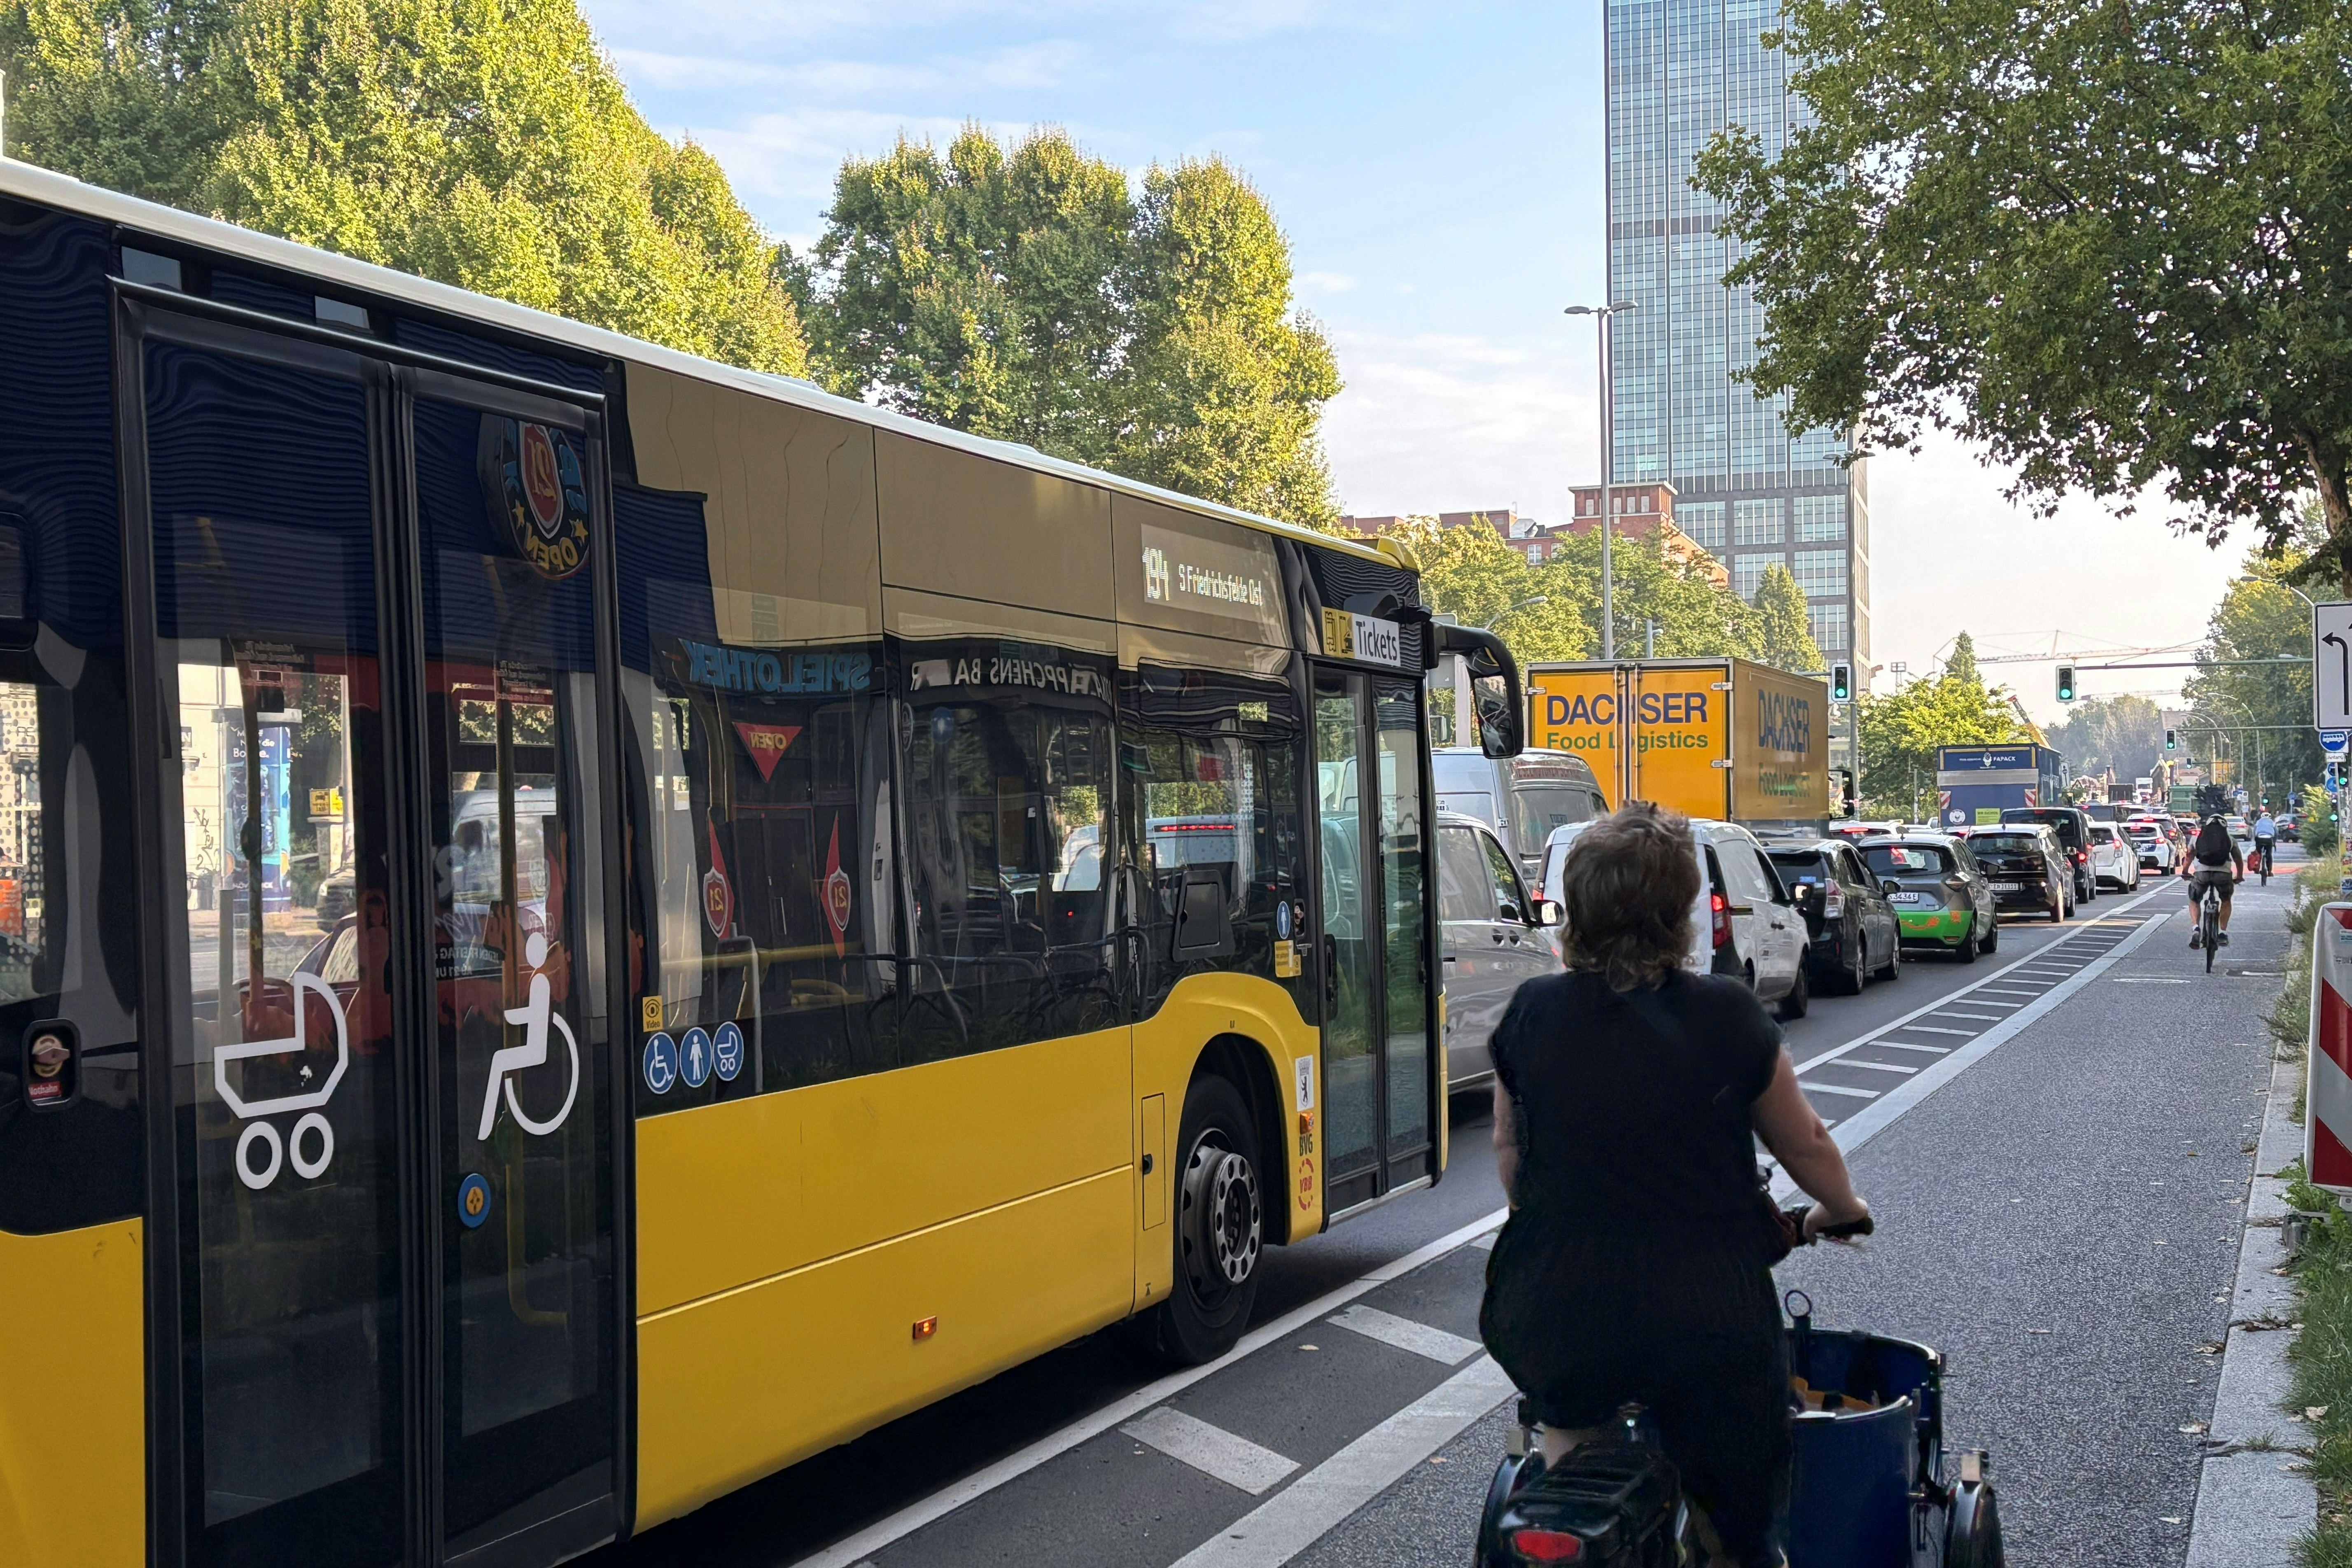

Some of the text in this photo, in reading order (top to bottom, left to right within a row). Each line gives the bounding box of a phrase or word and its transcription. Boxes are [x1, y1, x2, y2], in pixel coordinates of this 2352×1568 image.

[1142, 547, 1262, 606] 194 S Friedrichsfelde Ost
[1356, 621, 1398, 661] Tickets
[1759, 689, 1810, 753] DACHSER
[1547, 730, 1708, 753] Food Lgistics
[1299, 1134, 1313, 1156] BVG
[1300, 1176, 1313, 1194] VBB
